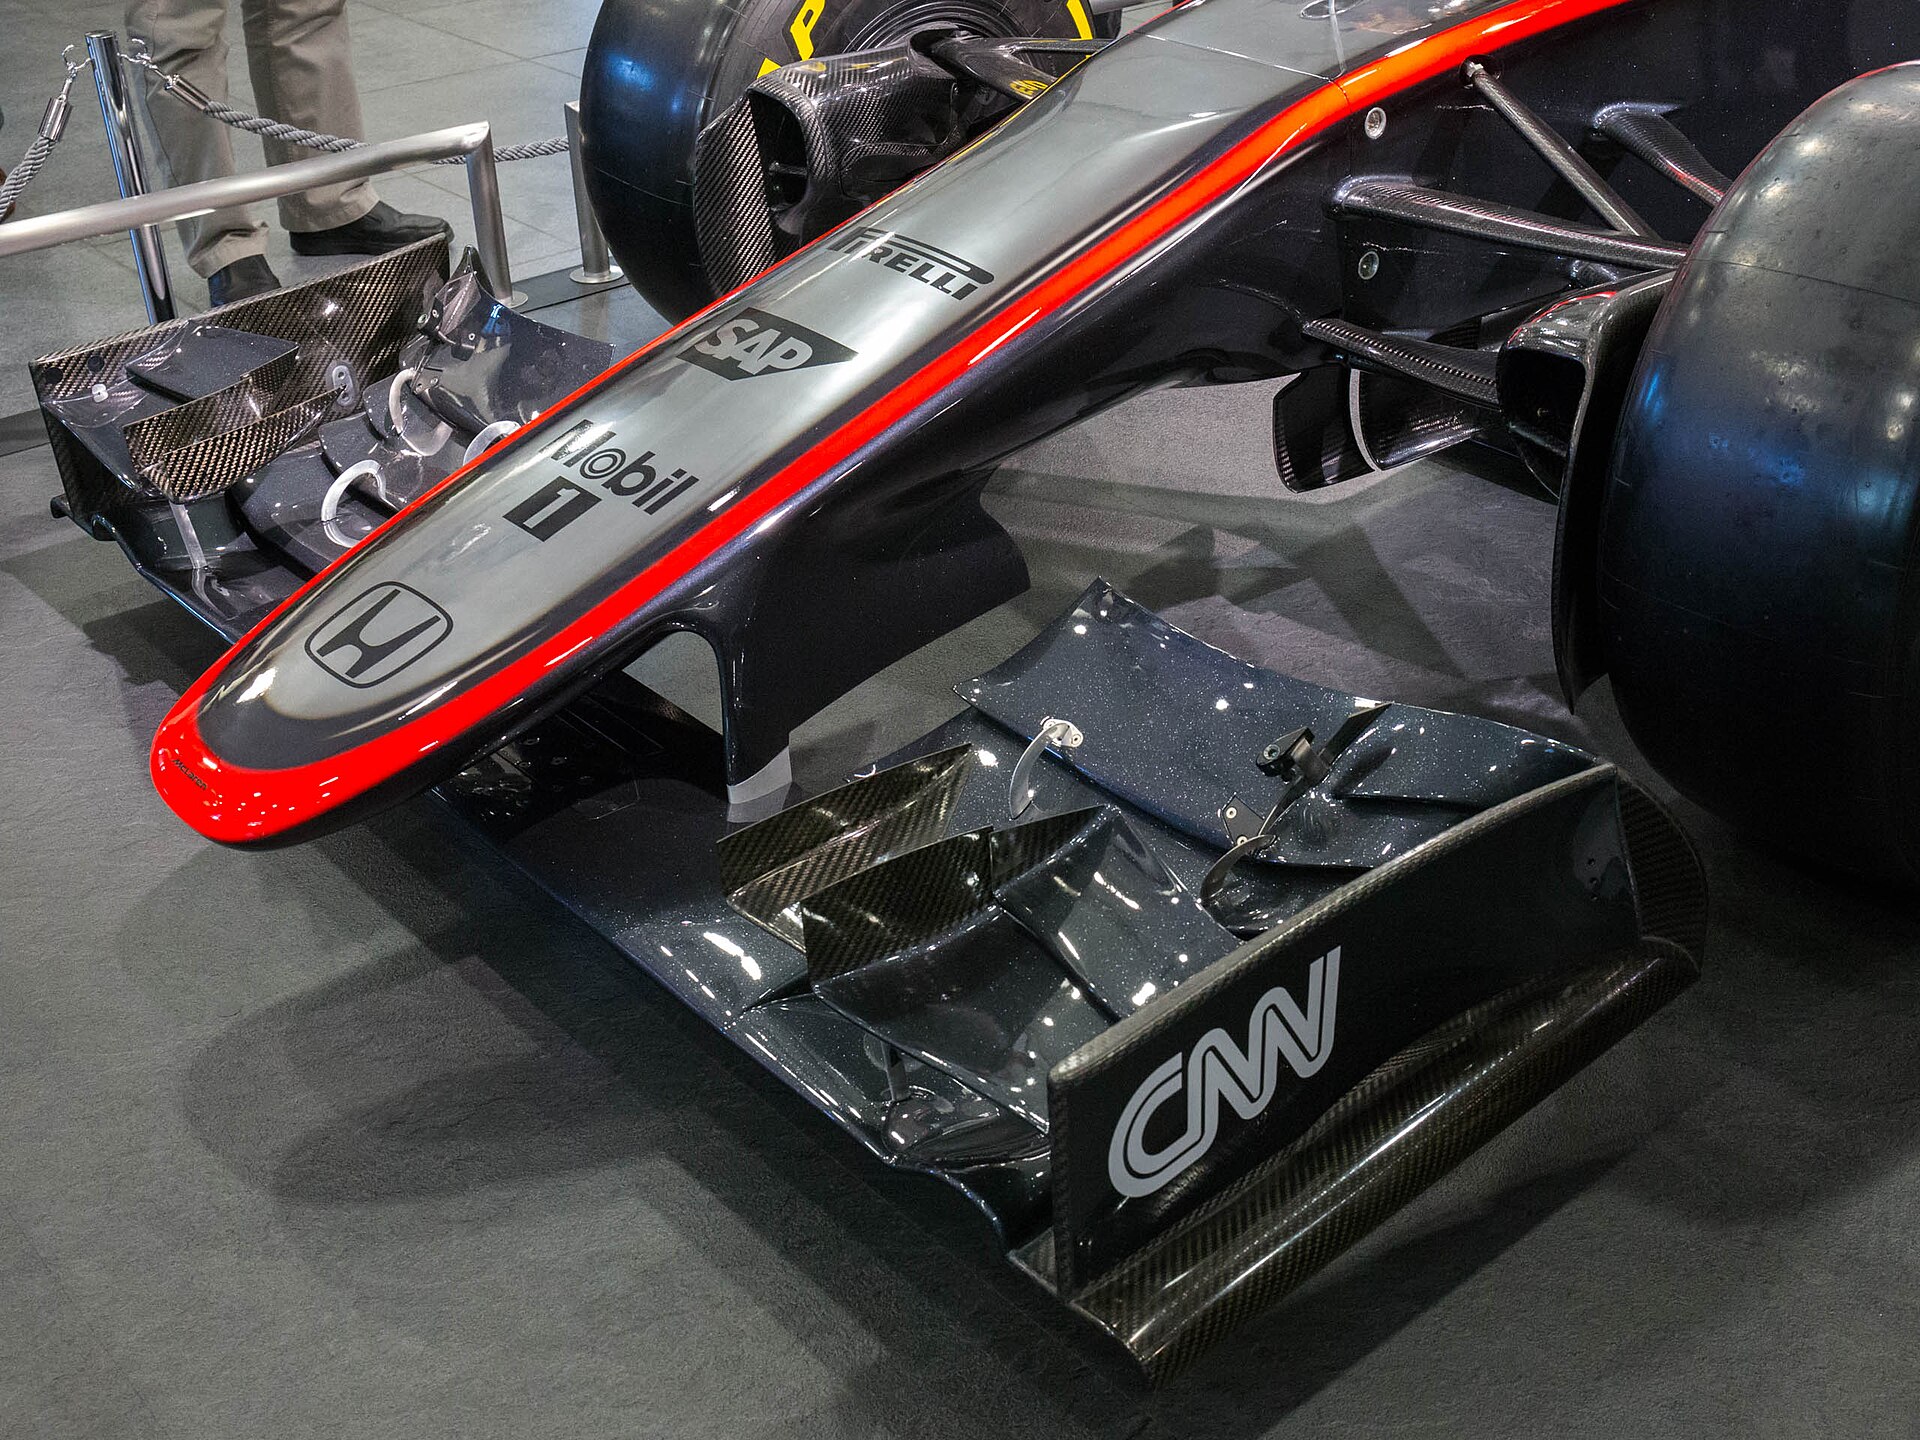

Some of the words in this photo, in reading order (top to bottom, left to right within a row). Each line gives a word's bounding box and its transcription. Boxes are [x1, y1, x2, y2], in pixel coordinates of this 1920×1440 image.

[827, 226, 994, 300] PIRELLI
[695, 319, 813, 375] SAP
[538, 419, 699, 516] Mobil
[522, 487, 580, 529] 1
[172, 759, 207, 790] McLaren
[1108, 945, 1341, 1198] CNN
